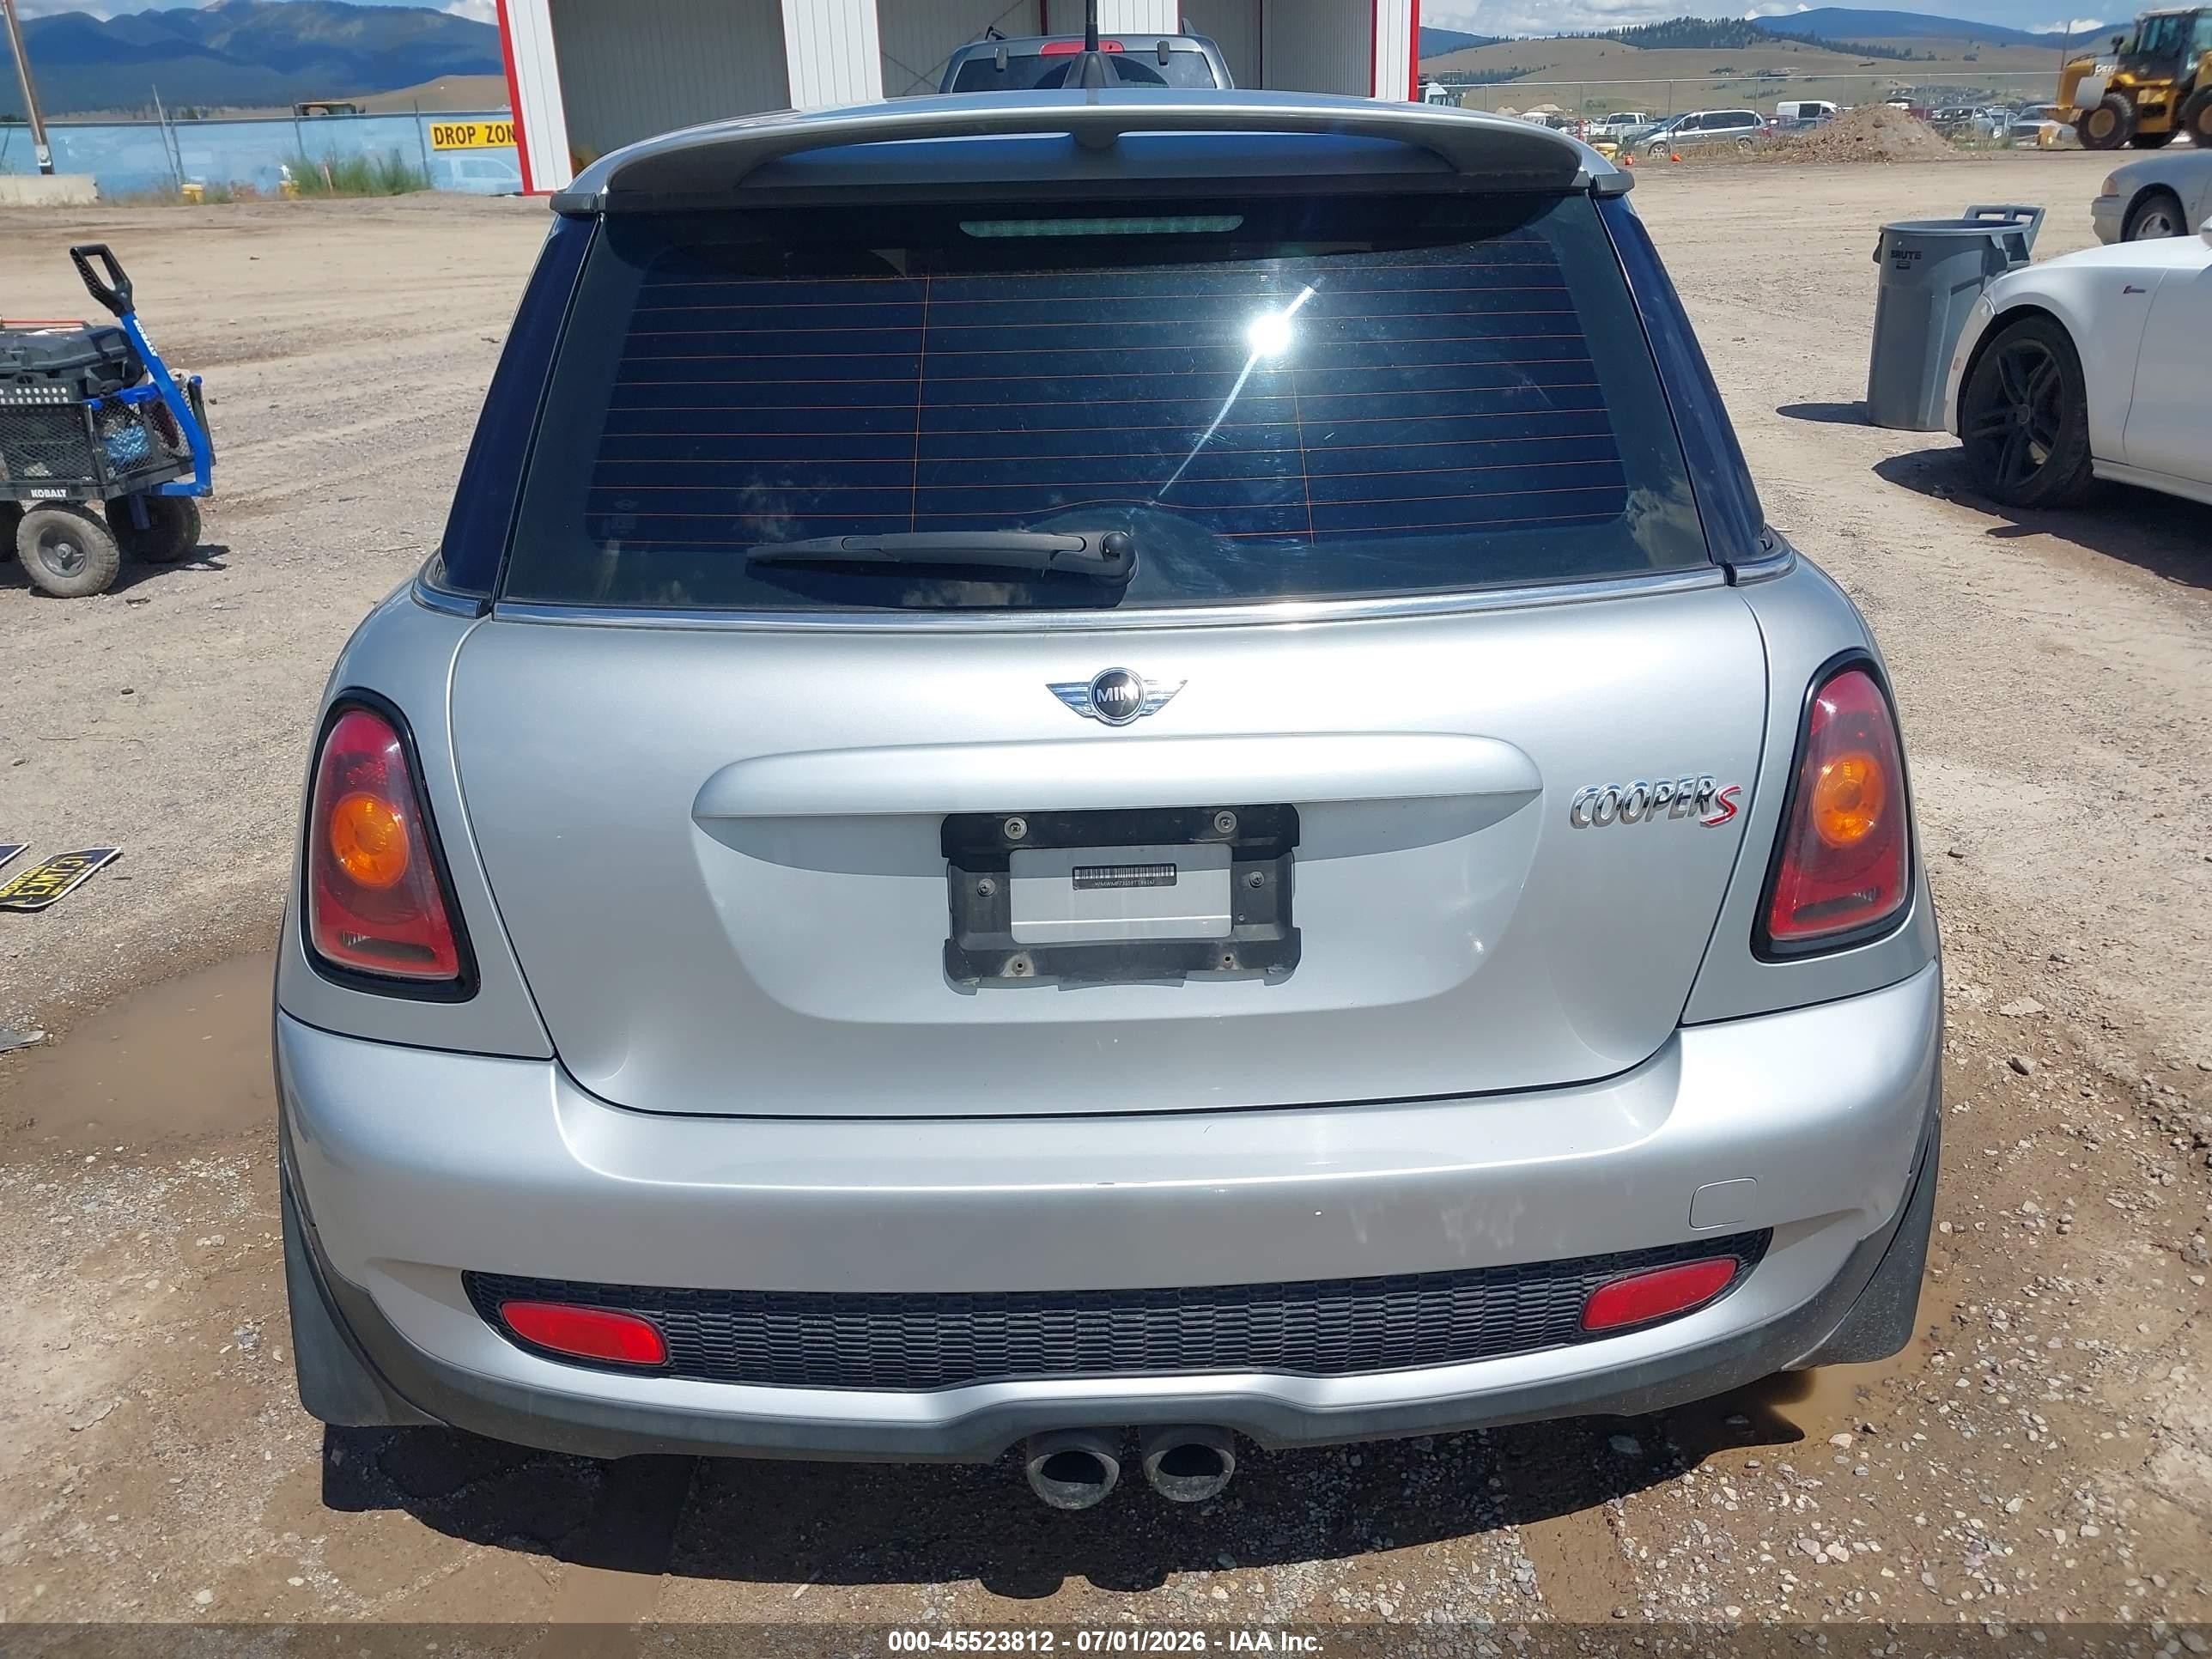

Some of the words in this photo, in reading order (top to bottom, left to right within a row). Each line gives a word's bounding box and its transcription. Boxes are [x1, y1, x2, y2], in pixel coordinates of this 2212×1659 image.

[433, 125, 477, 145] DROP
[1890, 249, 1922, 260] BRUTE
[132, 319, 158, 357] KOBALT
[30, 489, 67, 498] KOBALT
[1097, 685, 1140, 702] MINI
[1570, 773, 1717, 830] COOPER
[1700, 784, 1744, 829] S
